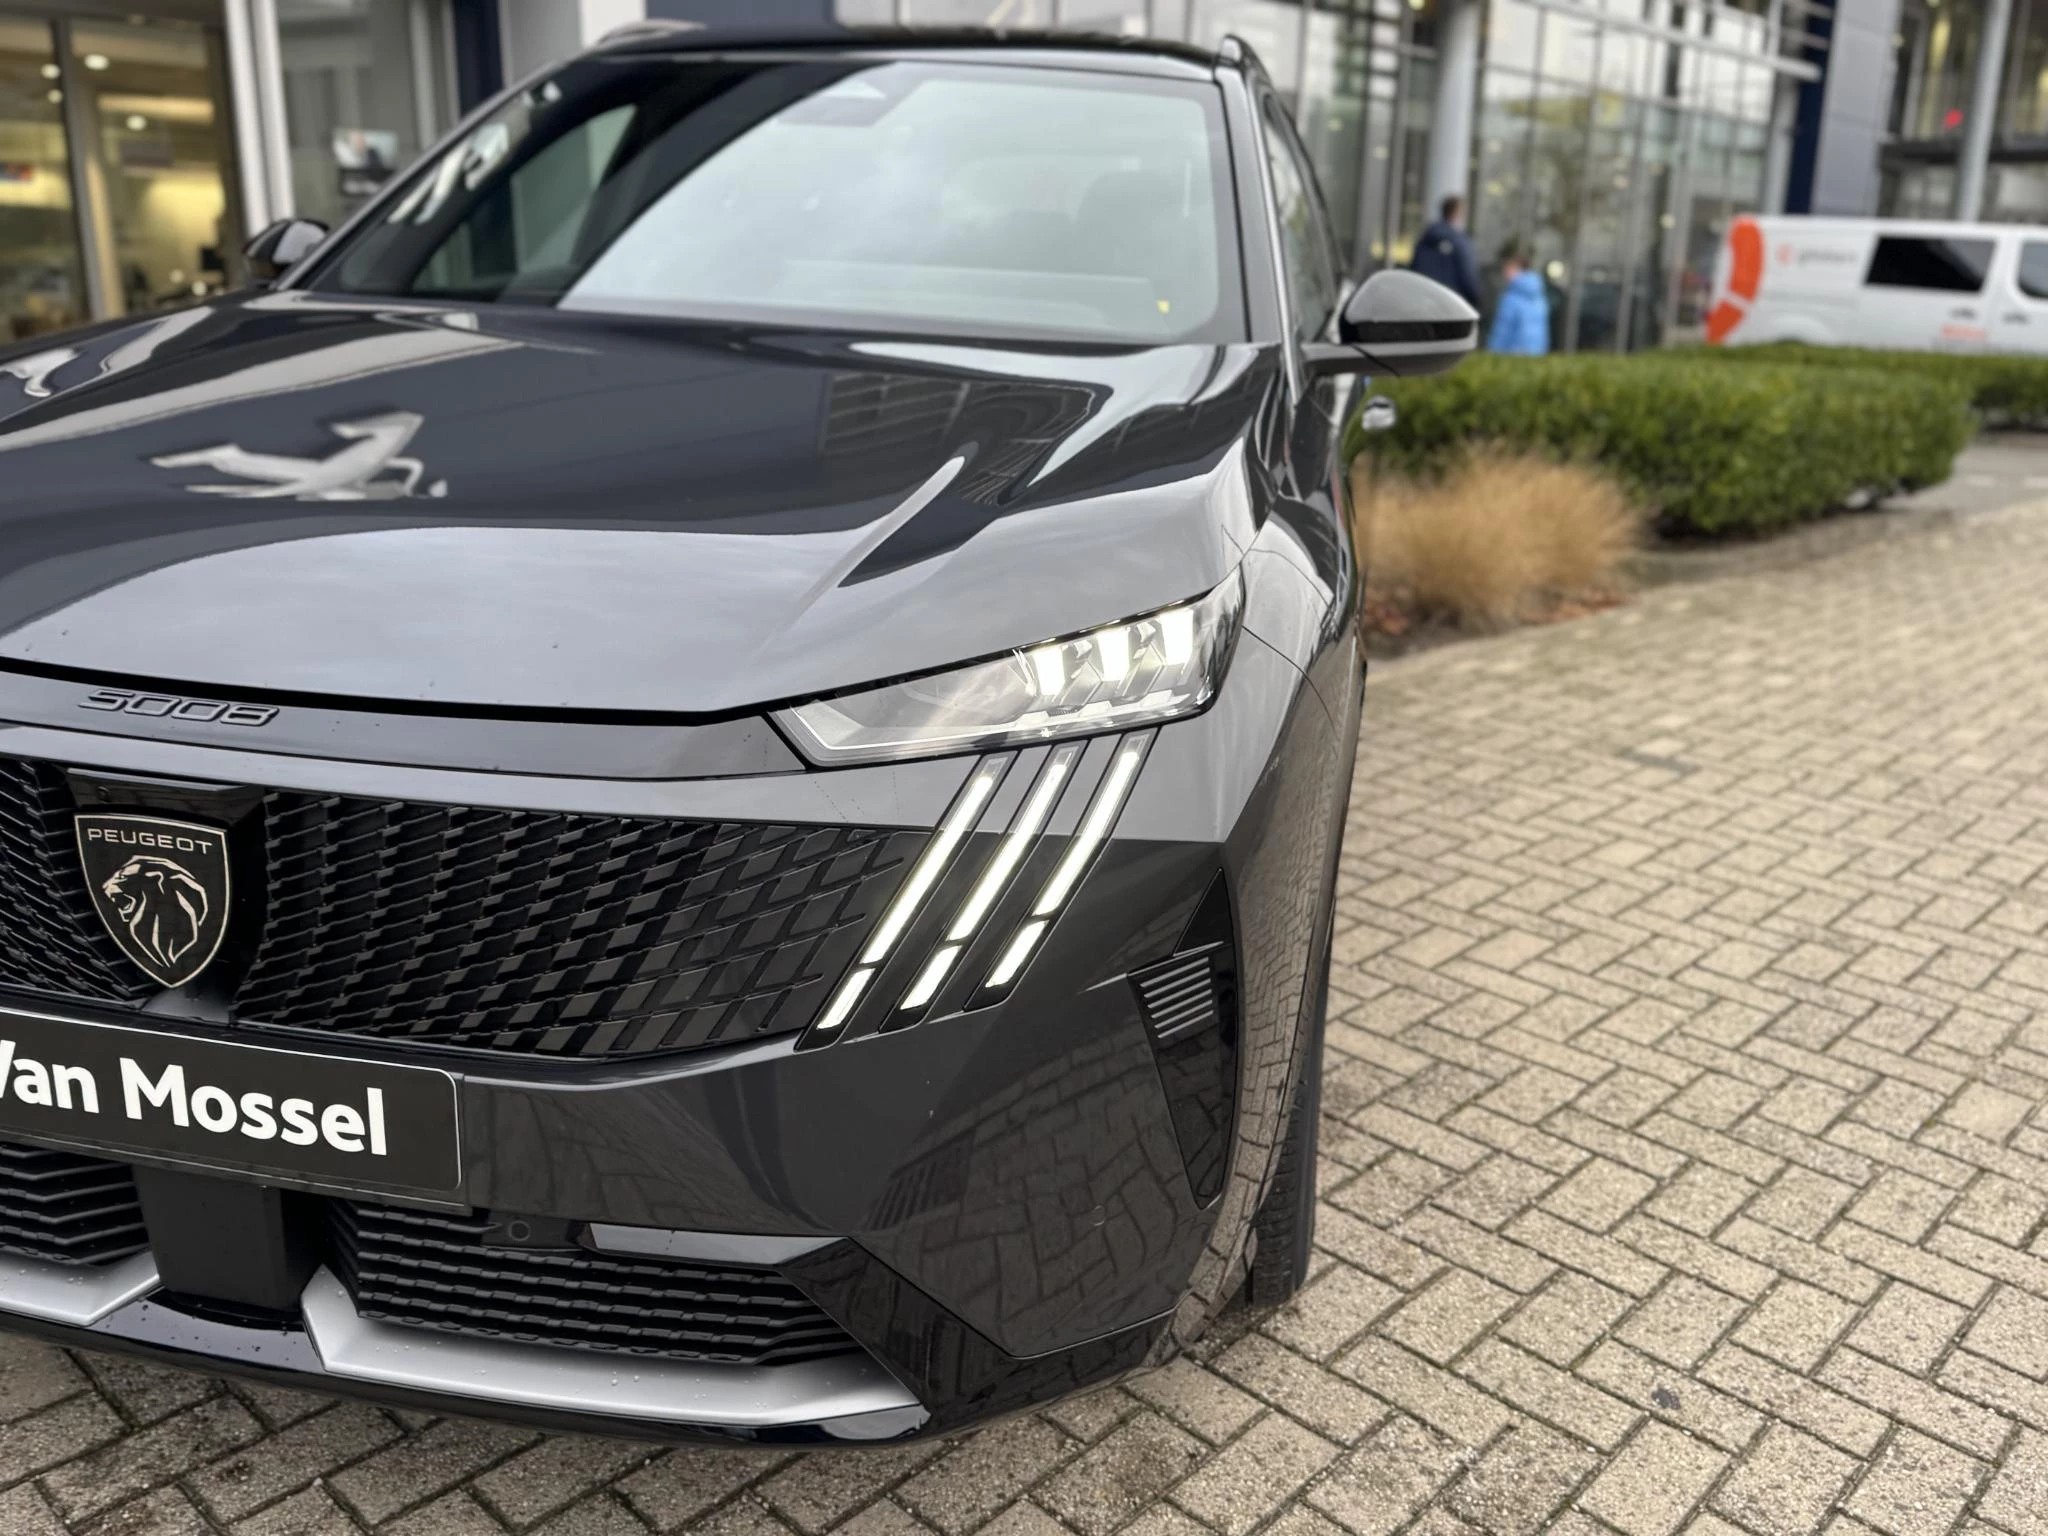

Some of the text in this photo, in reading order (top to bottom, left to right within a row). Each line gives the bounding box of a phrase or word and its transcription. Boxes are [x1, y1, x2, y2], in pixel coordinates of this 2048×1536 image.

[78, 688, 280, 727] 5008
[87, 827, 213, 855] PEUGEOT
[119, 1057, 387, 1156] Mossel
